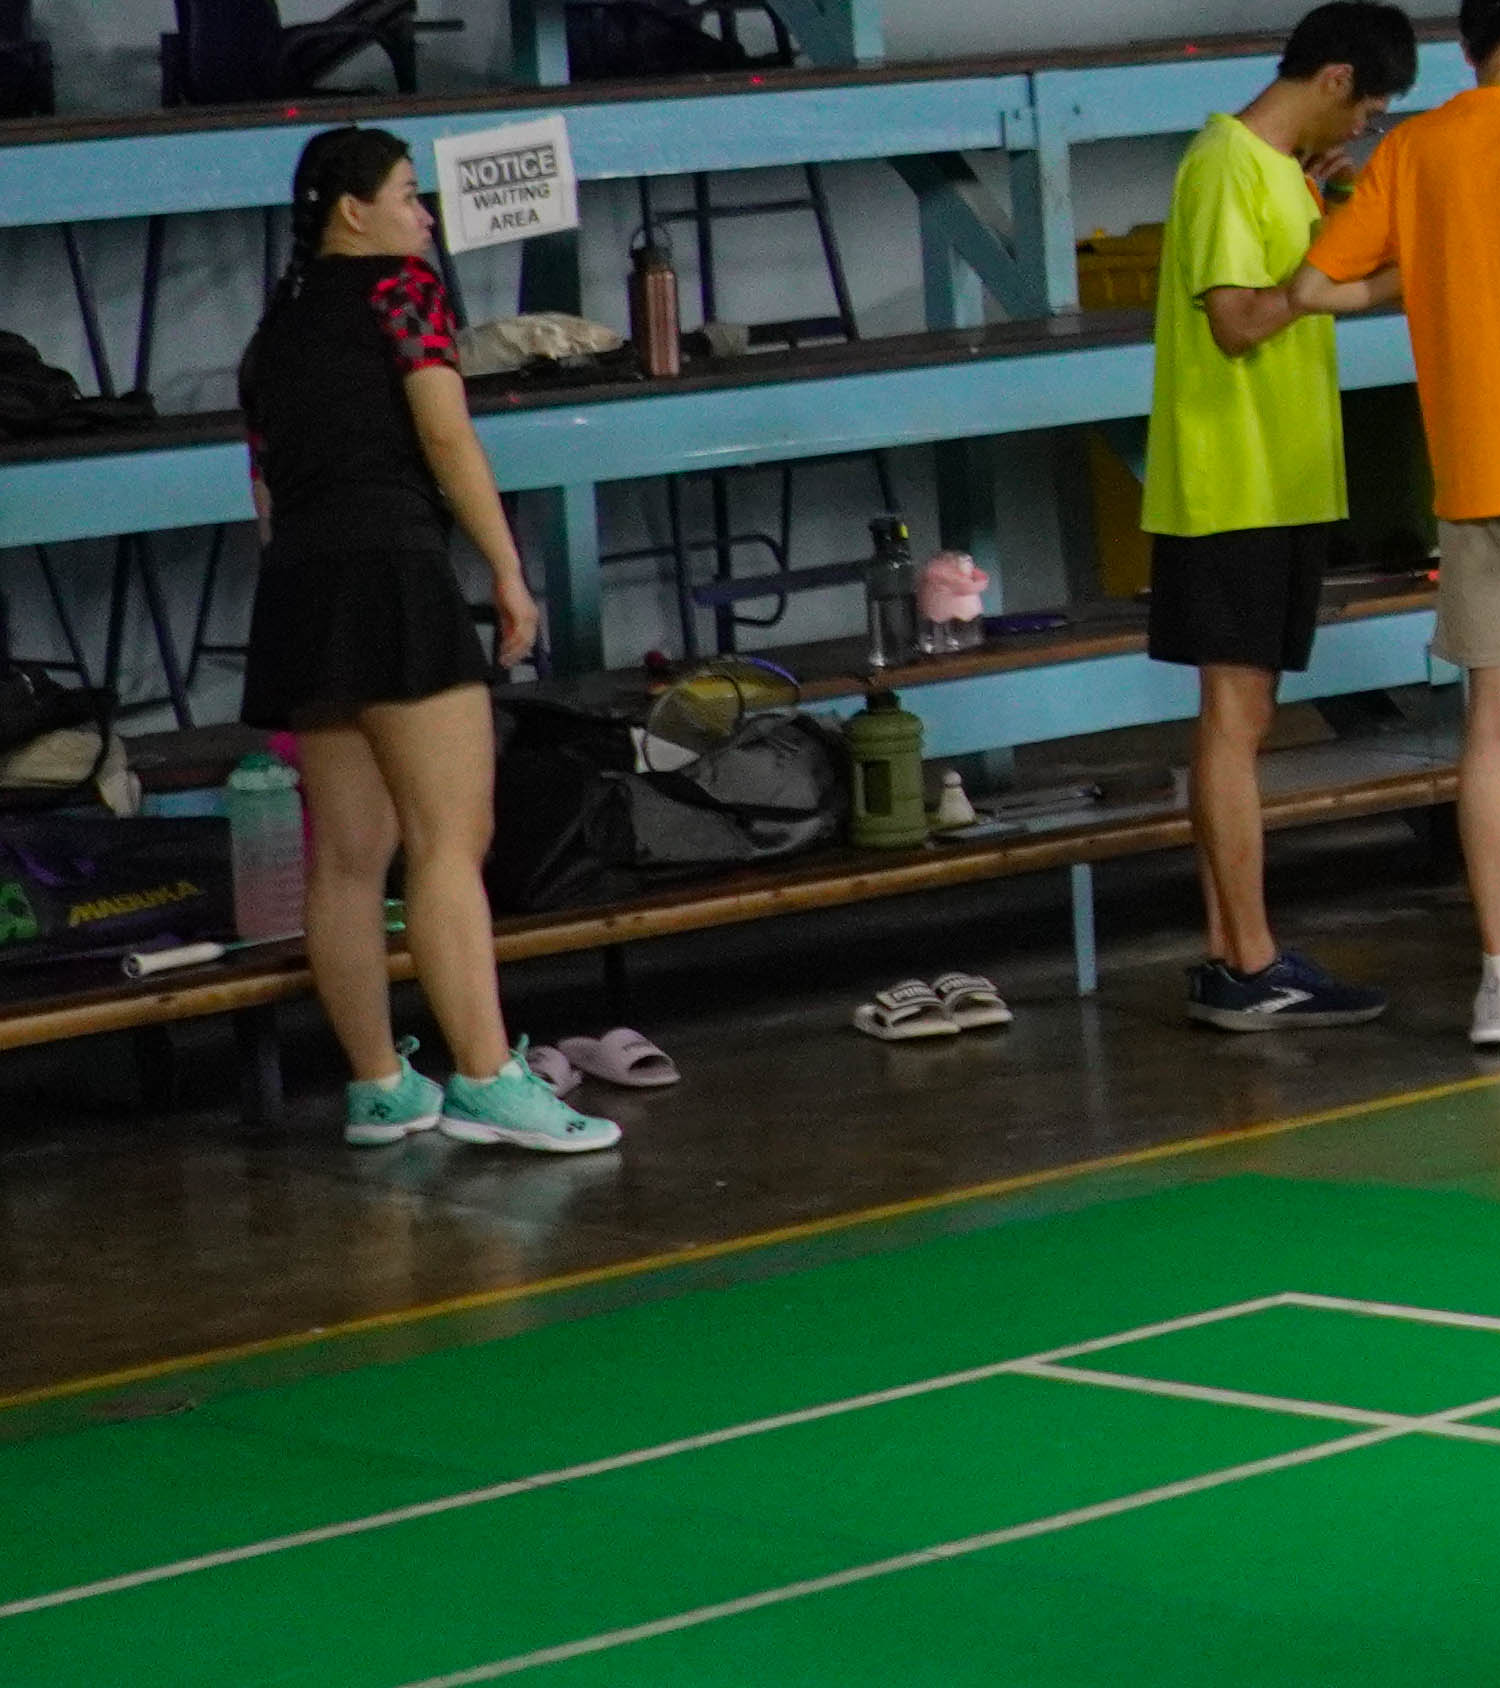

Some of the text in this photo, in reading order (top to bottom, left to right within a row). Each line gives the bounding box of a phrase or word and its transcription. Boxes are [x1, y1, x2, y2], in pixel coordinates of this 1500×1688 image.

[460, 148, 557, 191] NOTICE
[473, 182, 551, 211] WAITING
[490, 208, 541, 231] AREA
